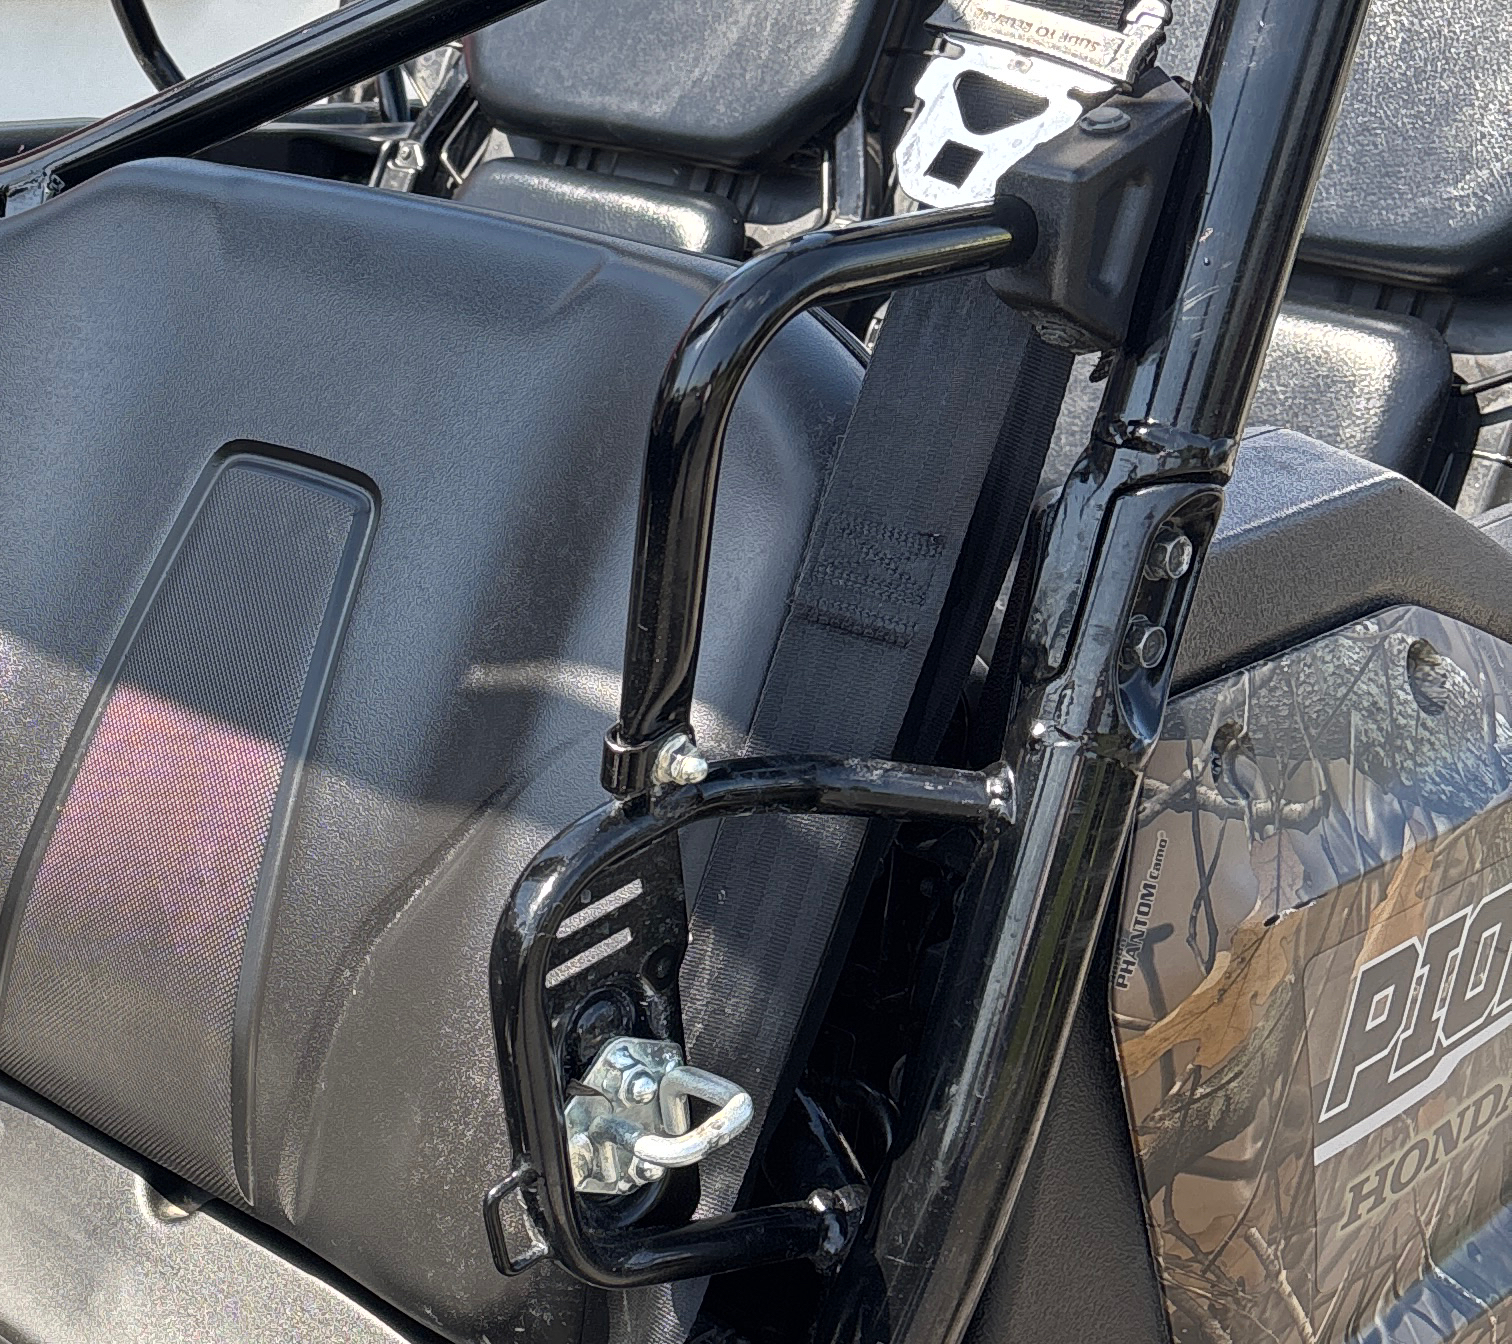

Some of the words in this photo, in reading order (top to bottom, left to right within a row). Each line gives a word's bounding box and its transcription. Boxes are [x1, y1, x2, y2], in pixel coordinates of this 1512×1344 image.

[1035, 25, 1056, 40] TO
[1116, 882, 1157, 989] PHANTOM
[1318, 883, 1512, 1123] PIO
[1340, 1082, 1512, 1231] HOND
